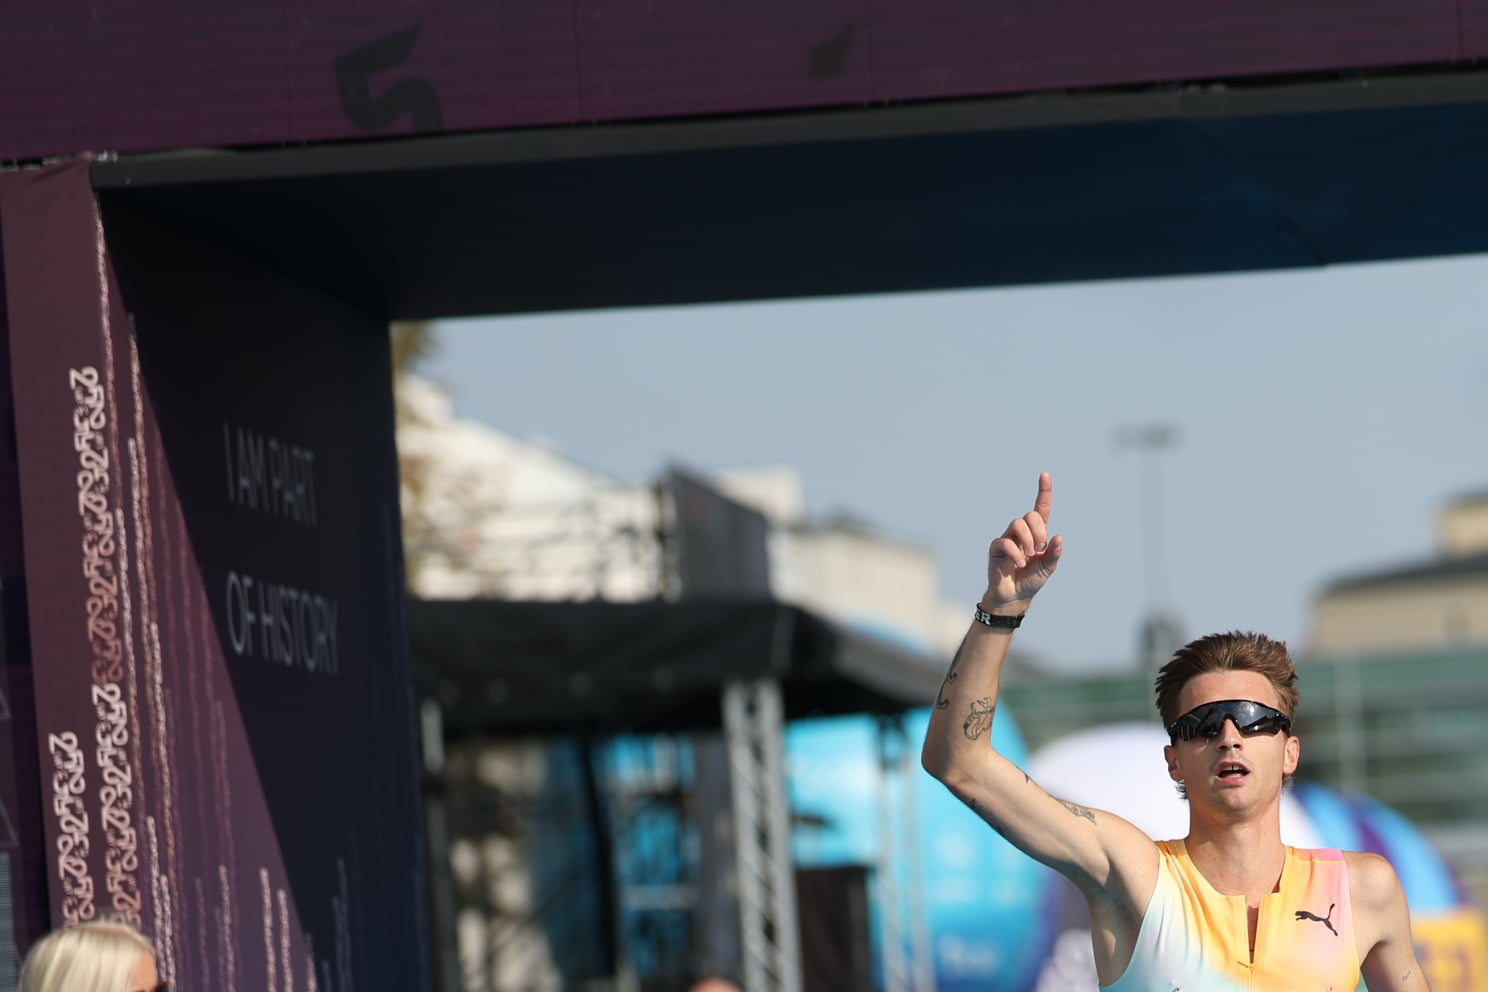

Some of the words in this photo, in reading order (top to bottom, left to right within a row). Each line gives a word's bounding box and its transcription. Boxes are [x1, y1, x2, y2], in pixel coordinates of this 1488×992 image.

[238, 428, 270, 512] AM
[269, 437, 317, 527] PART
[226, 571, 255, 656] OF
[258, 581, 338, 675] HISTORY
